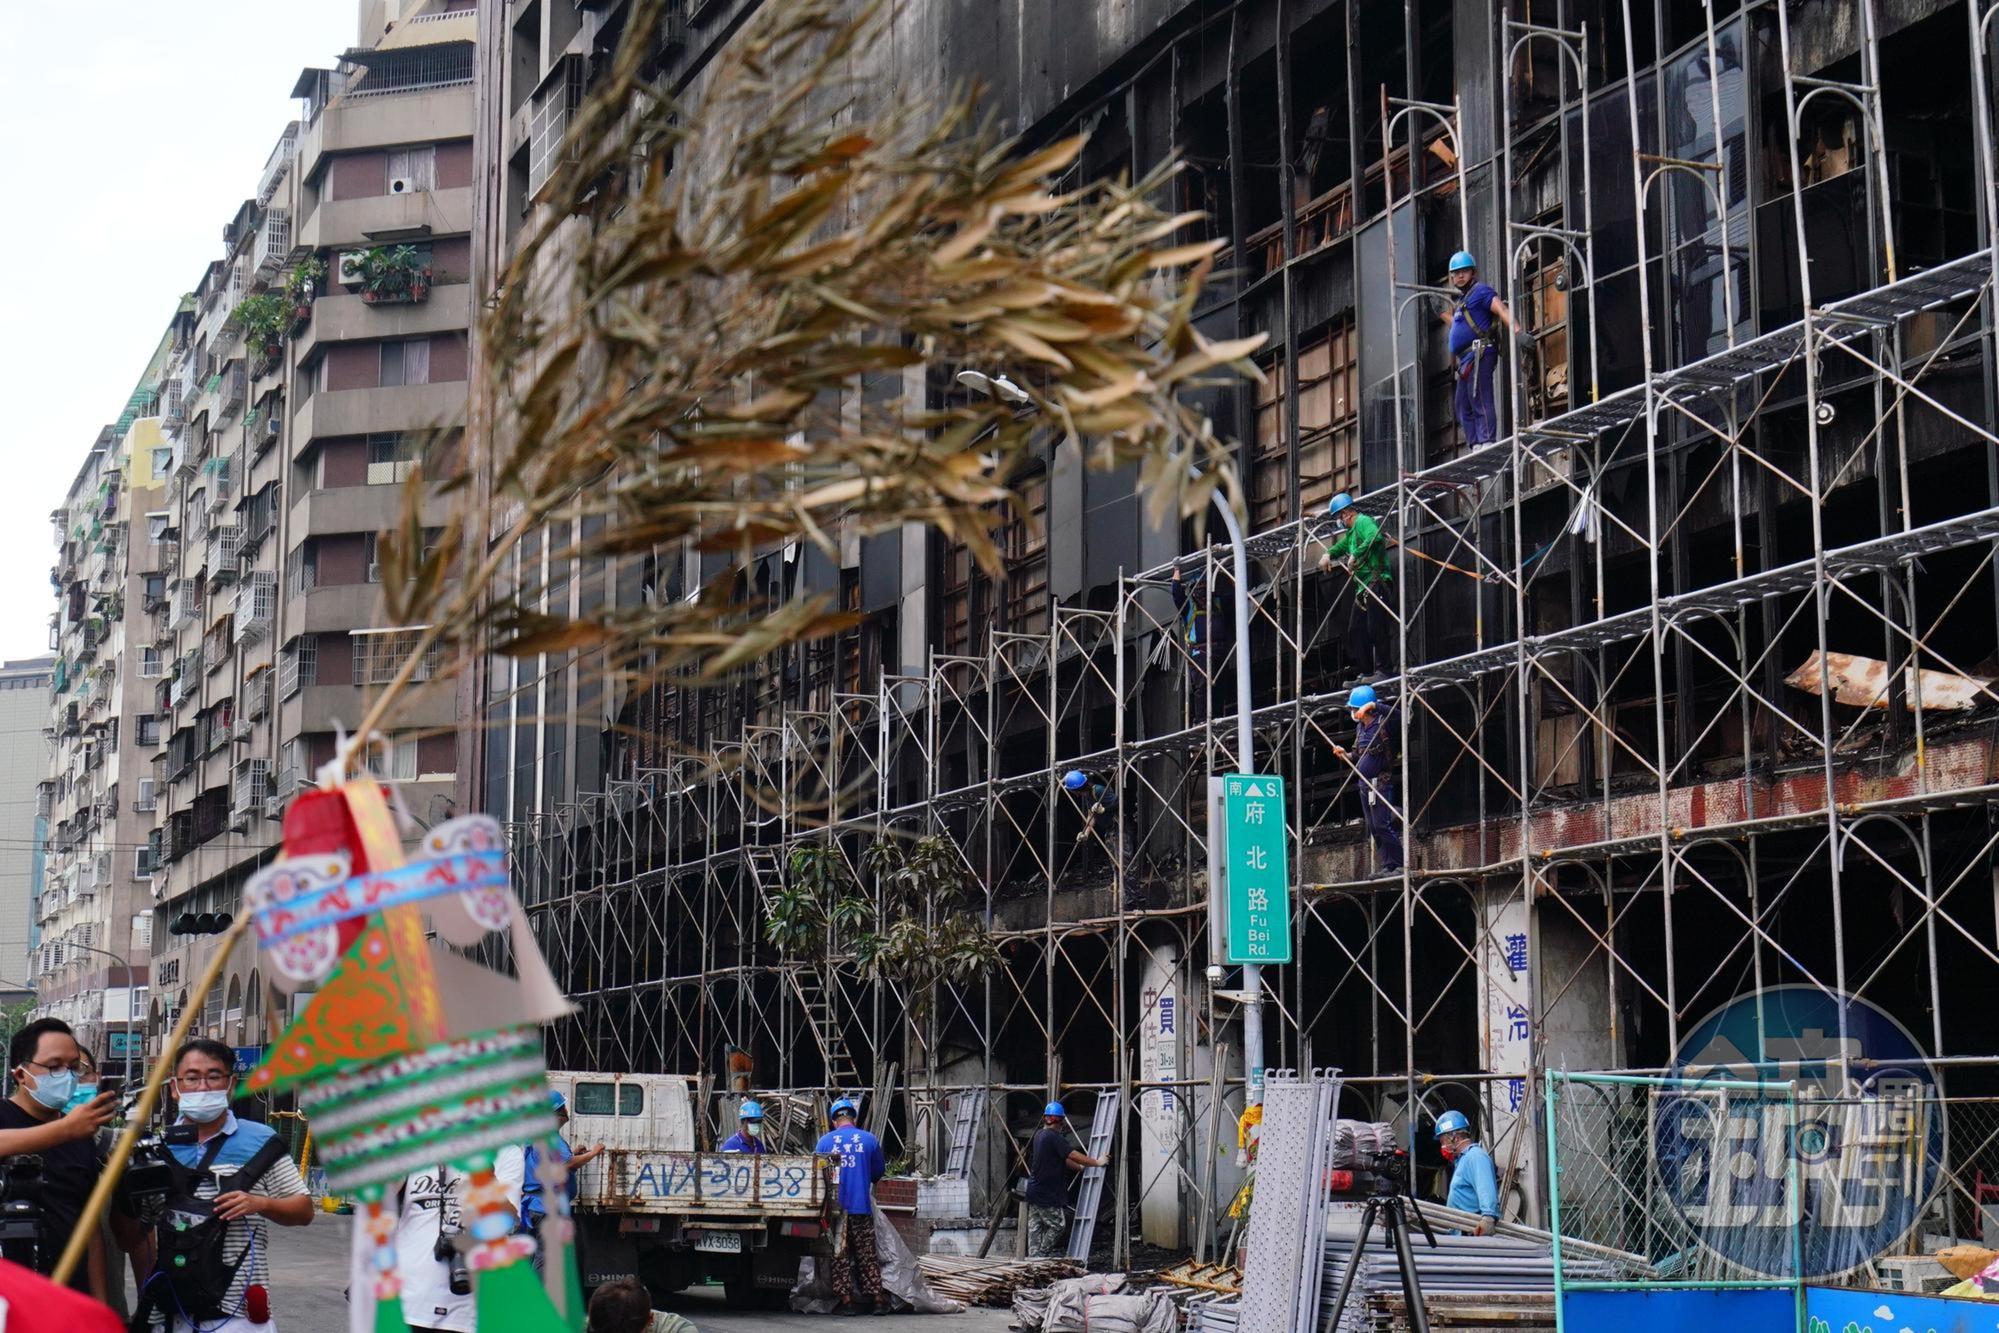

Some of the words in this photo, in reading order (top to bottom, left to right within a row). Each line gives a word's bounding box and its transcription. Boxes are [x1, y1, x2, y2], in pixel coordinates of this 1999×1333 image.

[1229, 781, 1242, 796] 南
[1266, 783, 1280, 798] S.
[1244, 800, 1269, 912] 府北路
[1250, 915, 1267, 928] Fu
[1248, 929, 1270, 942] Bei
[1249, 943, 1270, 956] Rd.
[840, 1155, 856, 1168] 53
[768, 1276, 795, 1285] HINO
